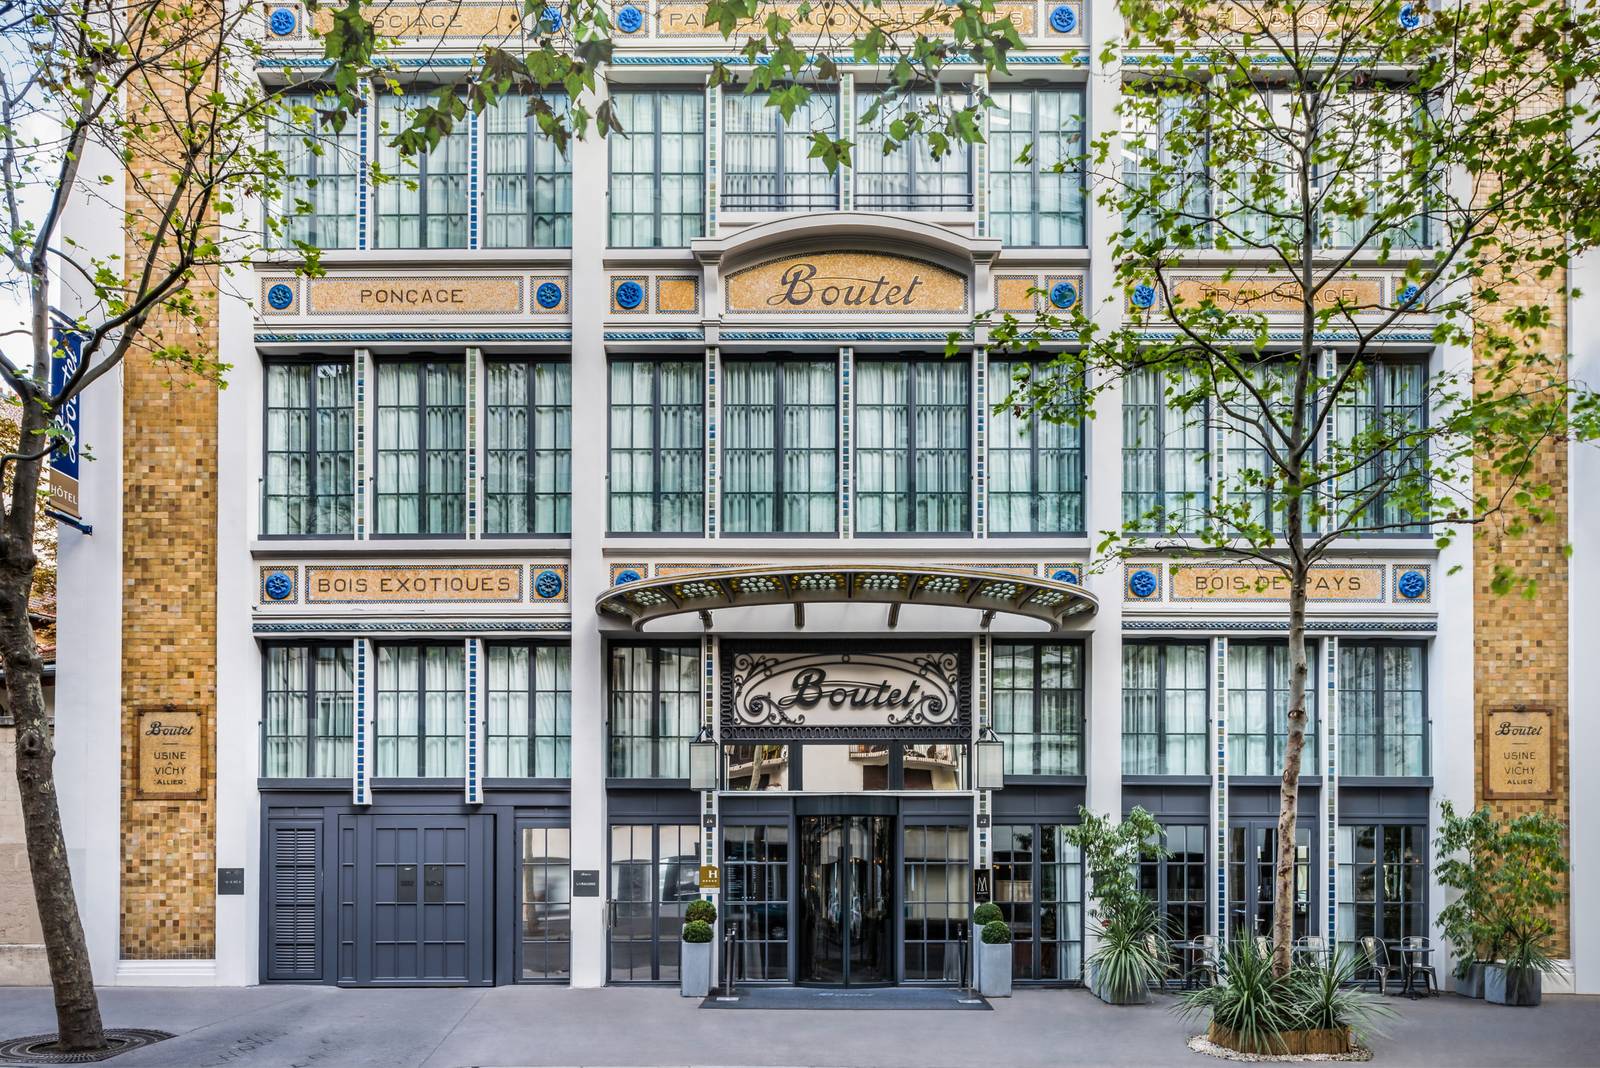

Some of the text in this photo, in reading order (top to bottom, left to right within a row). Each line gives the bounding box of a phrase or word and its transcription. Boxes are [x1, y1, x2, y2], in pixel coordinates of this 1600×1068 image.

[372, 14, 463, 28] SCIAGE
[766, 263, 923, 306] Boutet
[360, 289, 464, 305] PONÇAGE
[50, 482, 78, 505] HÔTEL
[318, 577, 510, 592] BOIS EXOTIQUES
[1195, 576, 1246, 591] BOIS
[1257, 576, 1285, 590] DE
[778, 667, 921, 710] Boutet
[145, 720, 194, 737] Boutet
[1494, 721, 1543, 736] Boutet
[153, 751, 187, 760] USINE
[1503, 751, 1537, 760] USINE
[154, 766, 187, 775] VICHY
[1504, 766, 1536, 775] VICHY
[708, 870, 718, 879] H
